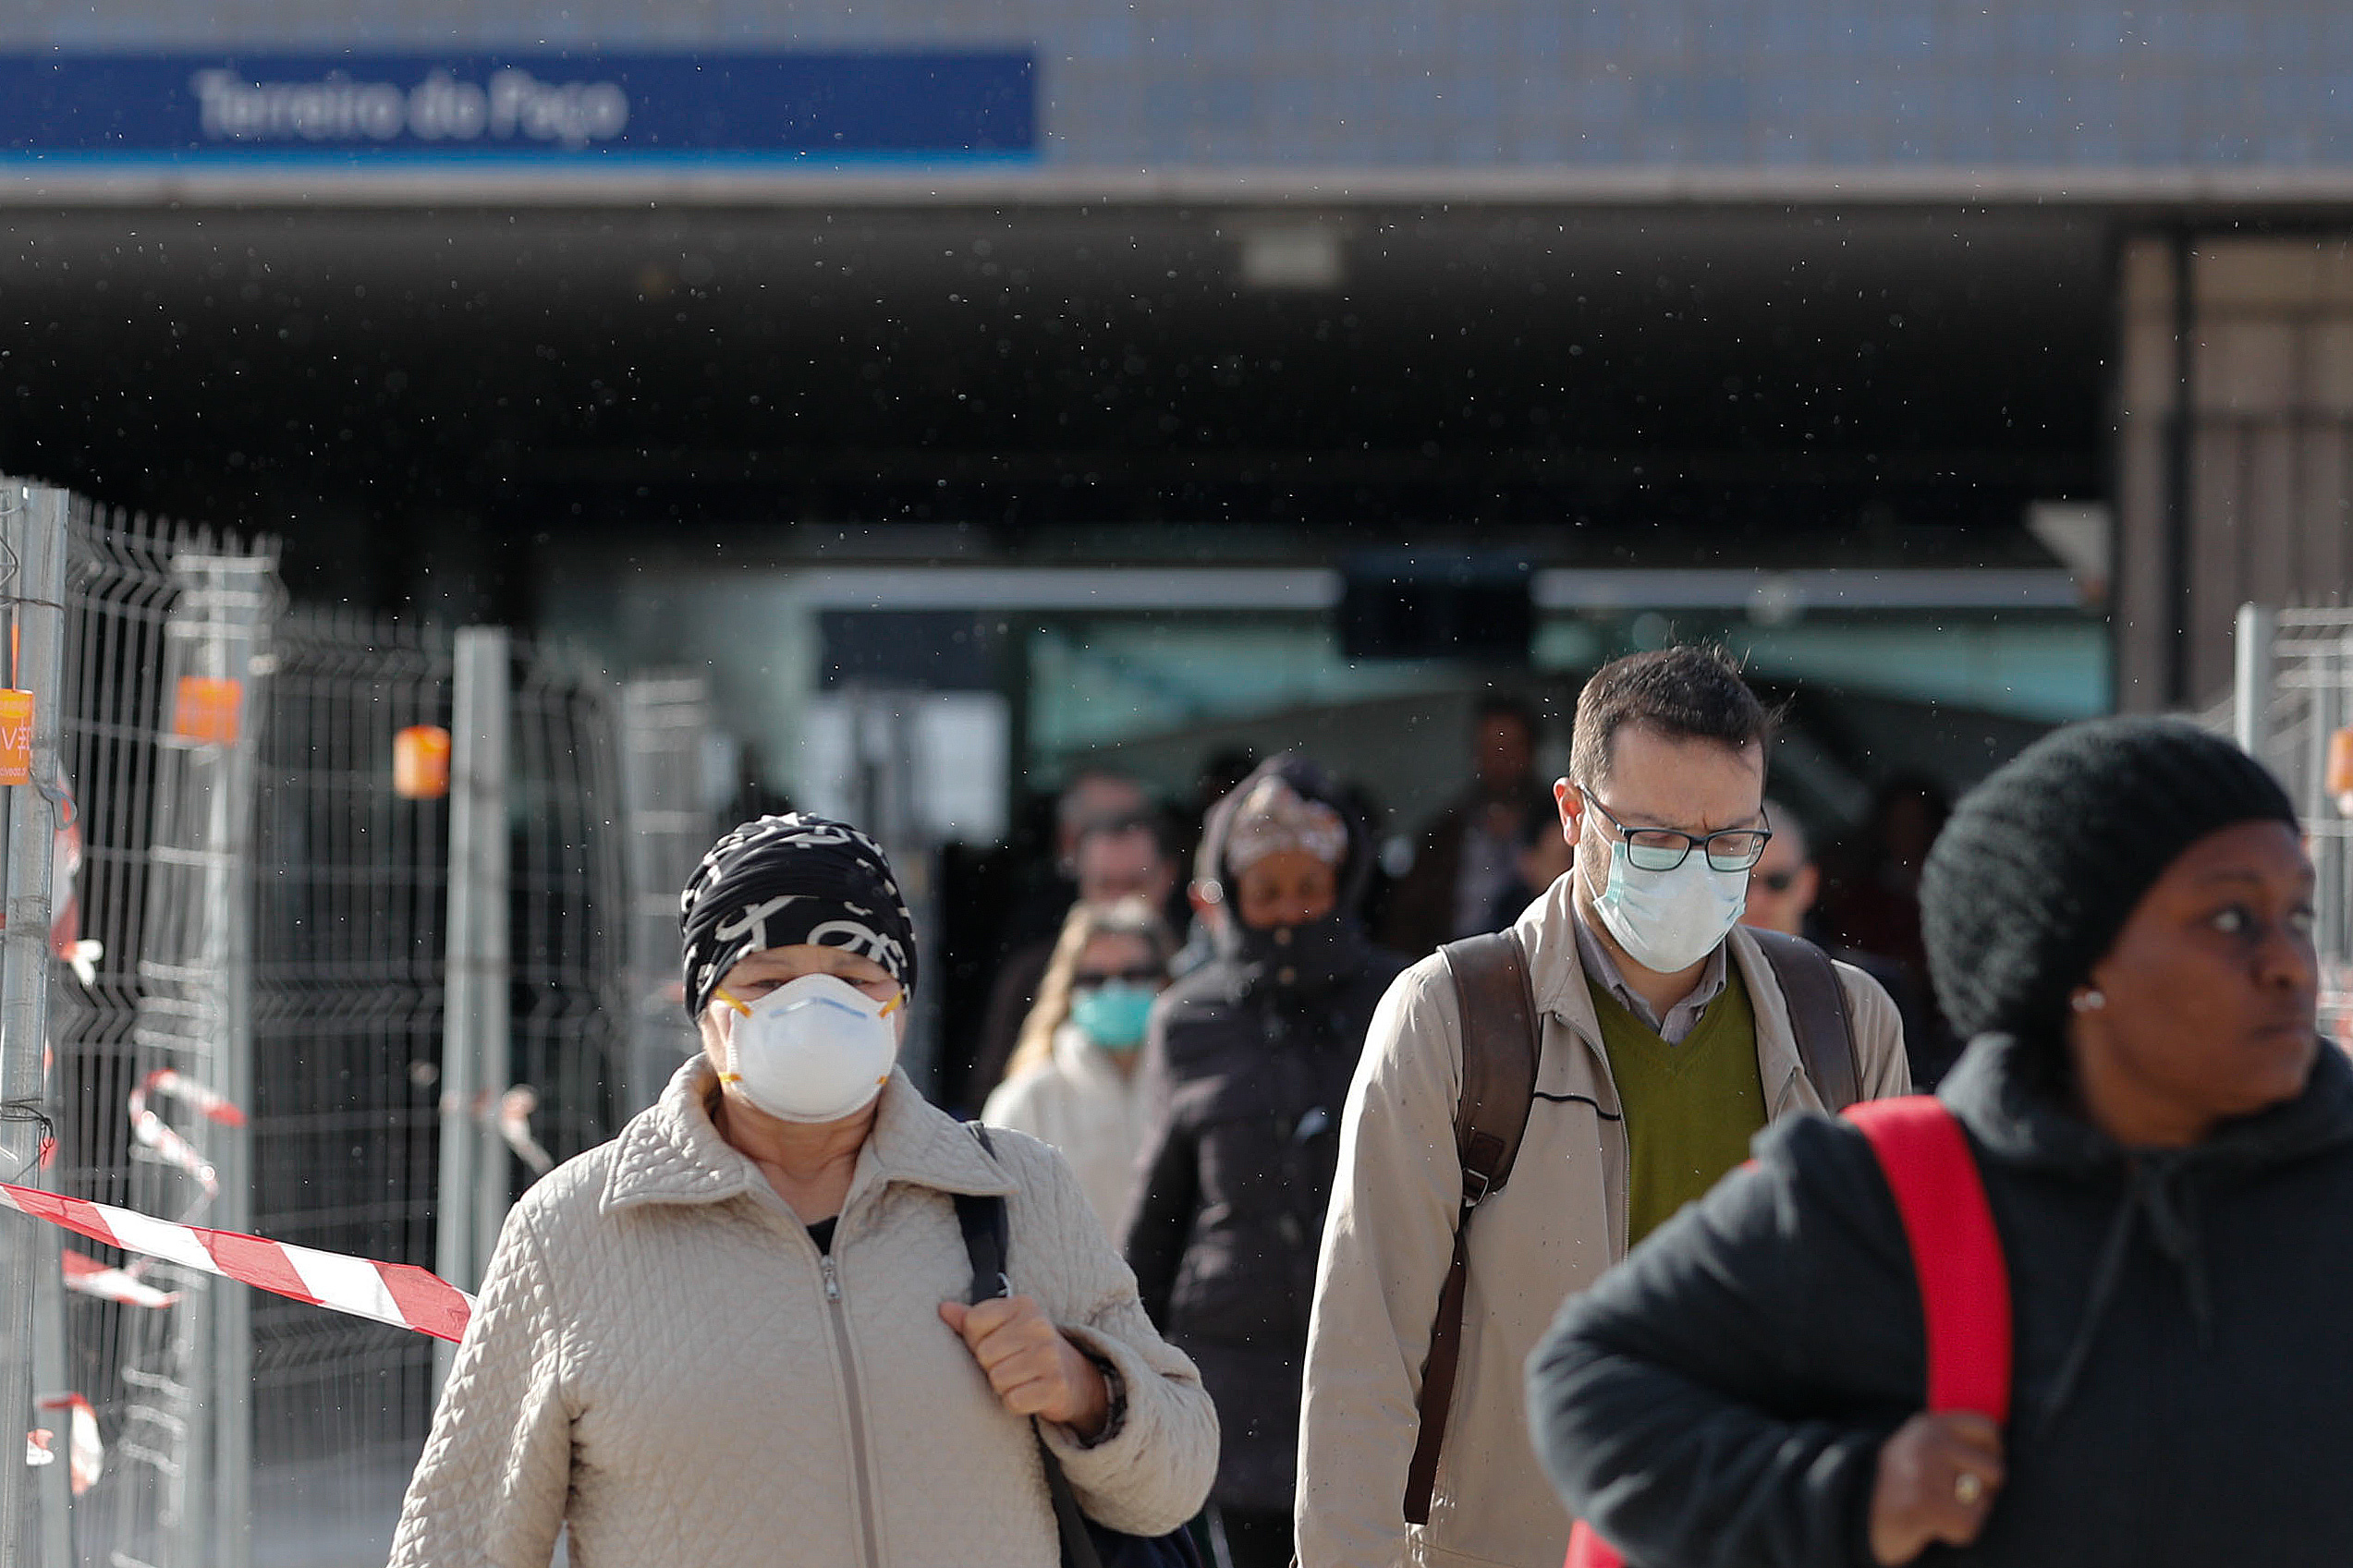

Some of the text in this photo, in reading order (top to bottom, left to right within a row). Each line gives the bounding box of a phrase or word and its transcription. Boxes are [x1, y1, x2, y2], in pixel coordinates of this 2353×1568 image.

[192, 68, 628, 148] Terreiro do Paço
